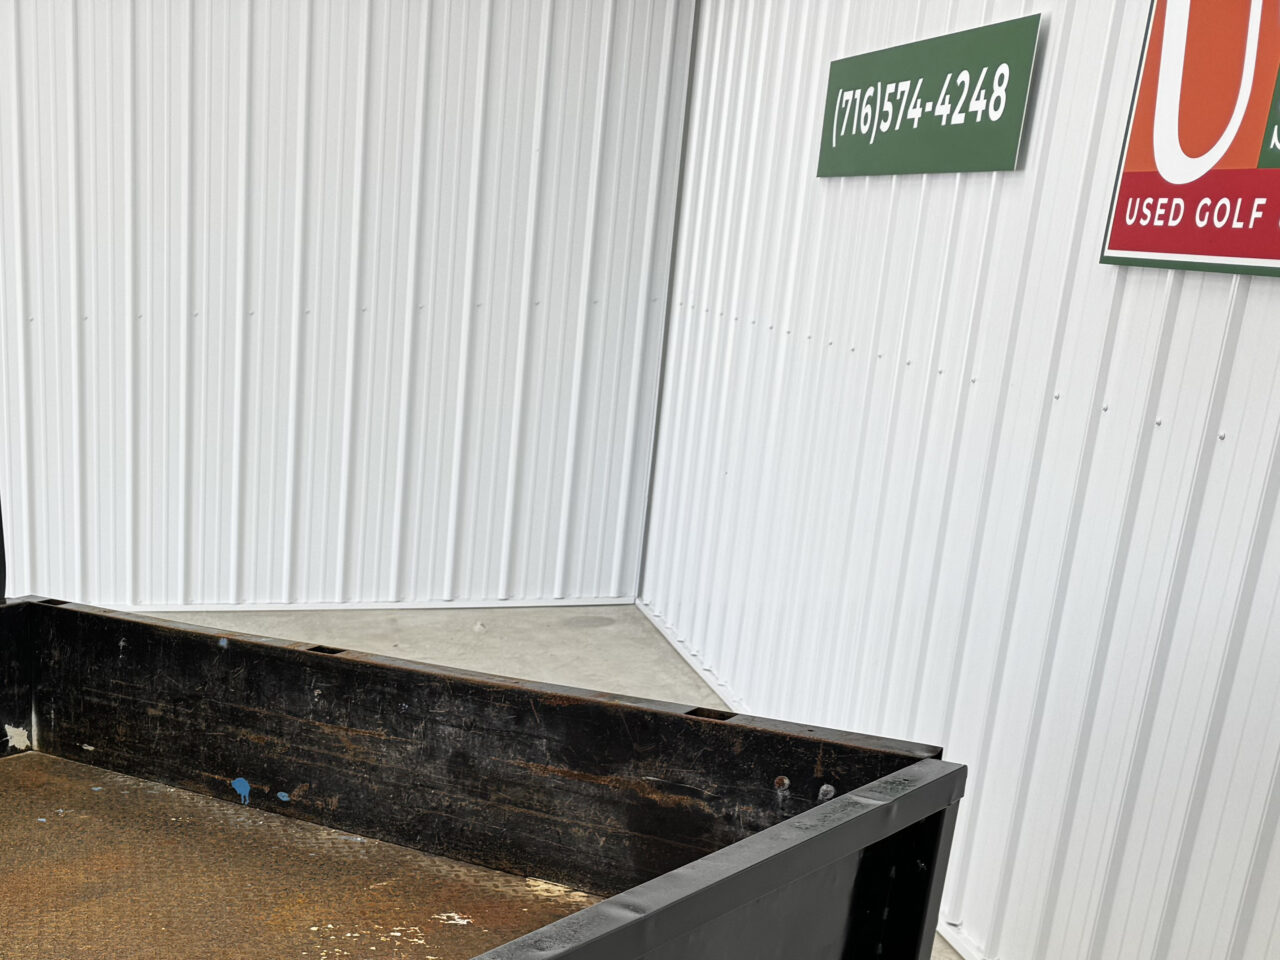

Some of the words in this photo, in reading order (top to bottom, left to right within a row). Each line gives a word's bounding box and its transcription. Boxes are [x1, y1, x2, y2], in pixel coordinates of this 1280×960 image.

[832, 62, 1010, 149] (716)574-4248
[1125, 197, 1185, 227] USED
[1195, 197, 1267, 229] GOLF
